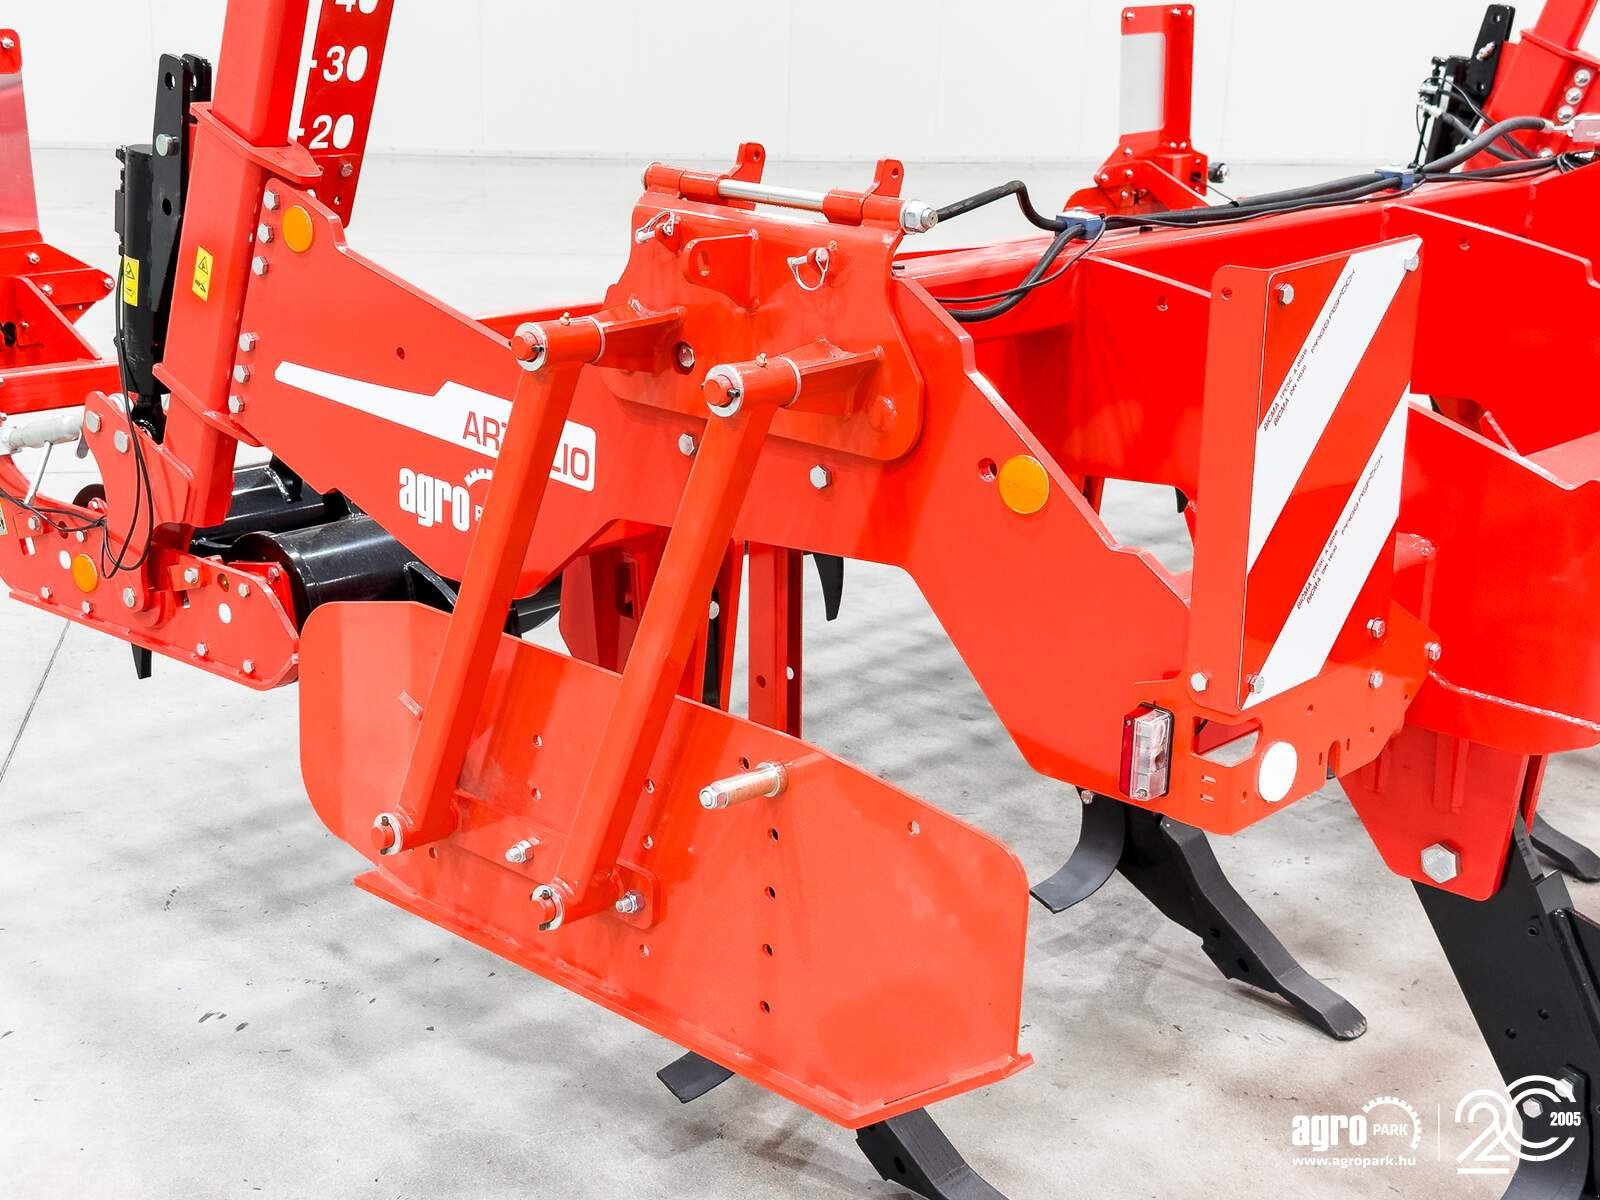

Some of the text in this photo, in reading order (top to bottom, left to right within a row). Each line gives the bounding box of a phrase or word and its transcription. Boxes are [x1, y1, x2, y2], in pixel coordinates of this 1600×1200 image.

[322, 45, 368, 83] 30
[308, 113, 355, 150] 20
[399, 467, 471, 533] agro
